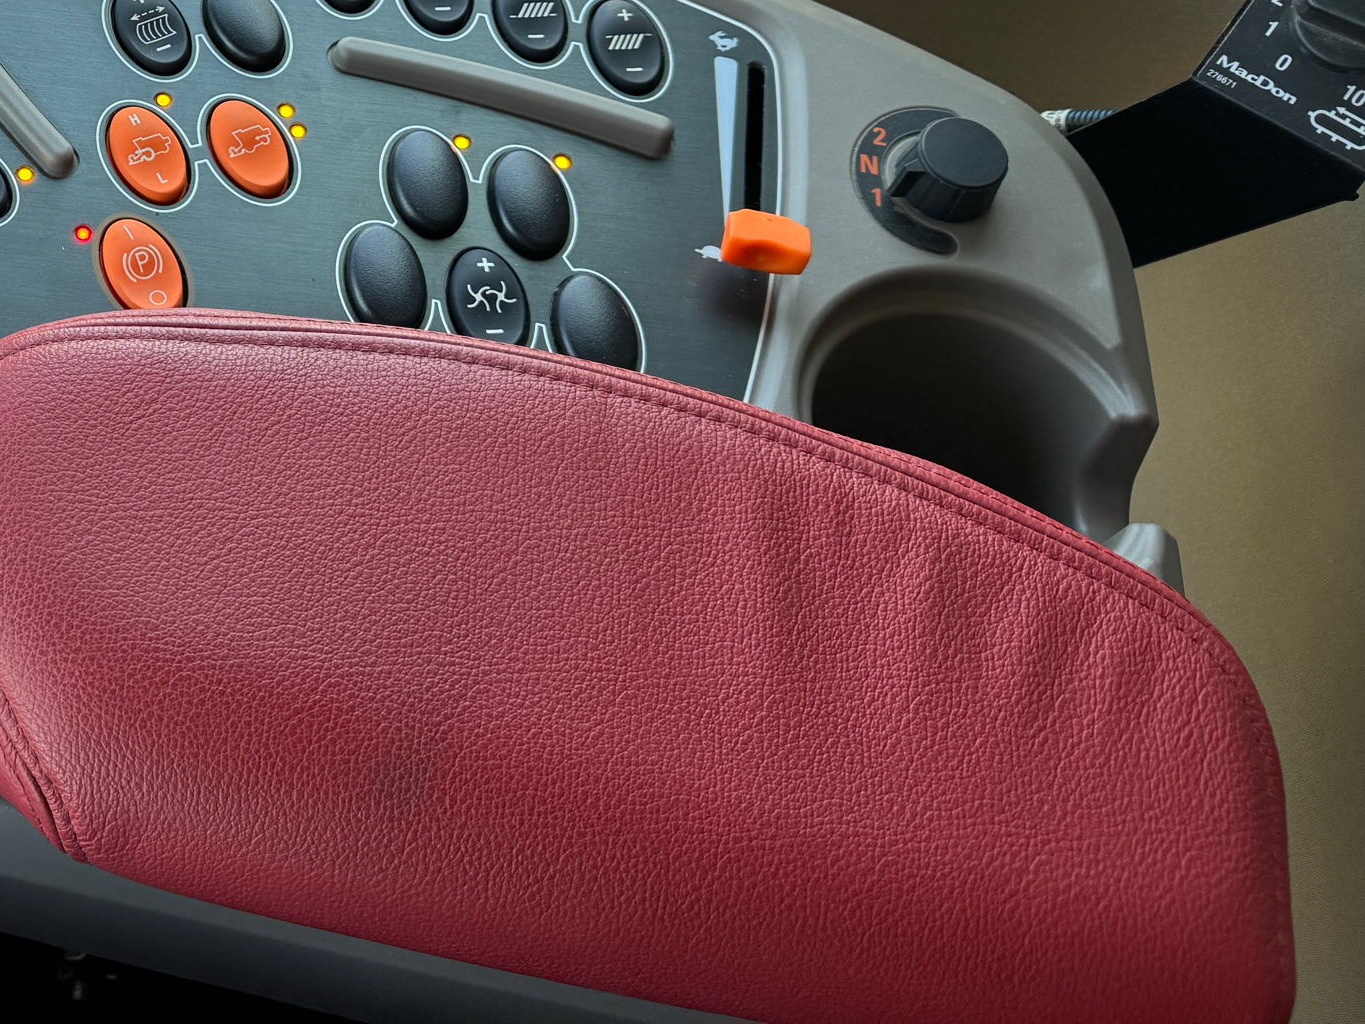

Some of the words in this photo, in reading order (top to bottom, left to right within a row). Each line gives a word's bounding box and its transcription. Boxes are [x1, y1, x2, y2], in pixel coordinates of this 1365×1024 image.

[1264, 21, 1279, 37] 1
[1275, 54, 1292, 72] 0
[1206, 68, 1237, 89] 276671
[1216, 54, 1298, 105] MacDon
[1343, 84, 1365, 107] 10
[128, 113, 141, 126] H
[872, 127, 887, 146] 2
[860, 154, 878, 175] N
[156, 172, 168, 184] L
[871, 188, 882, 207] 1
